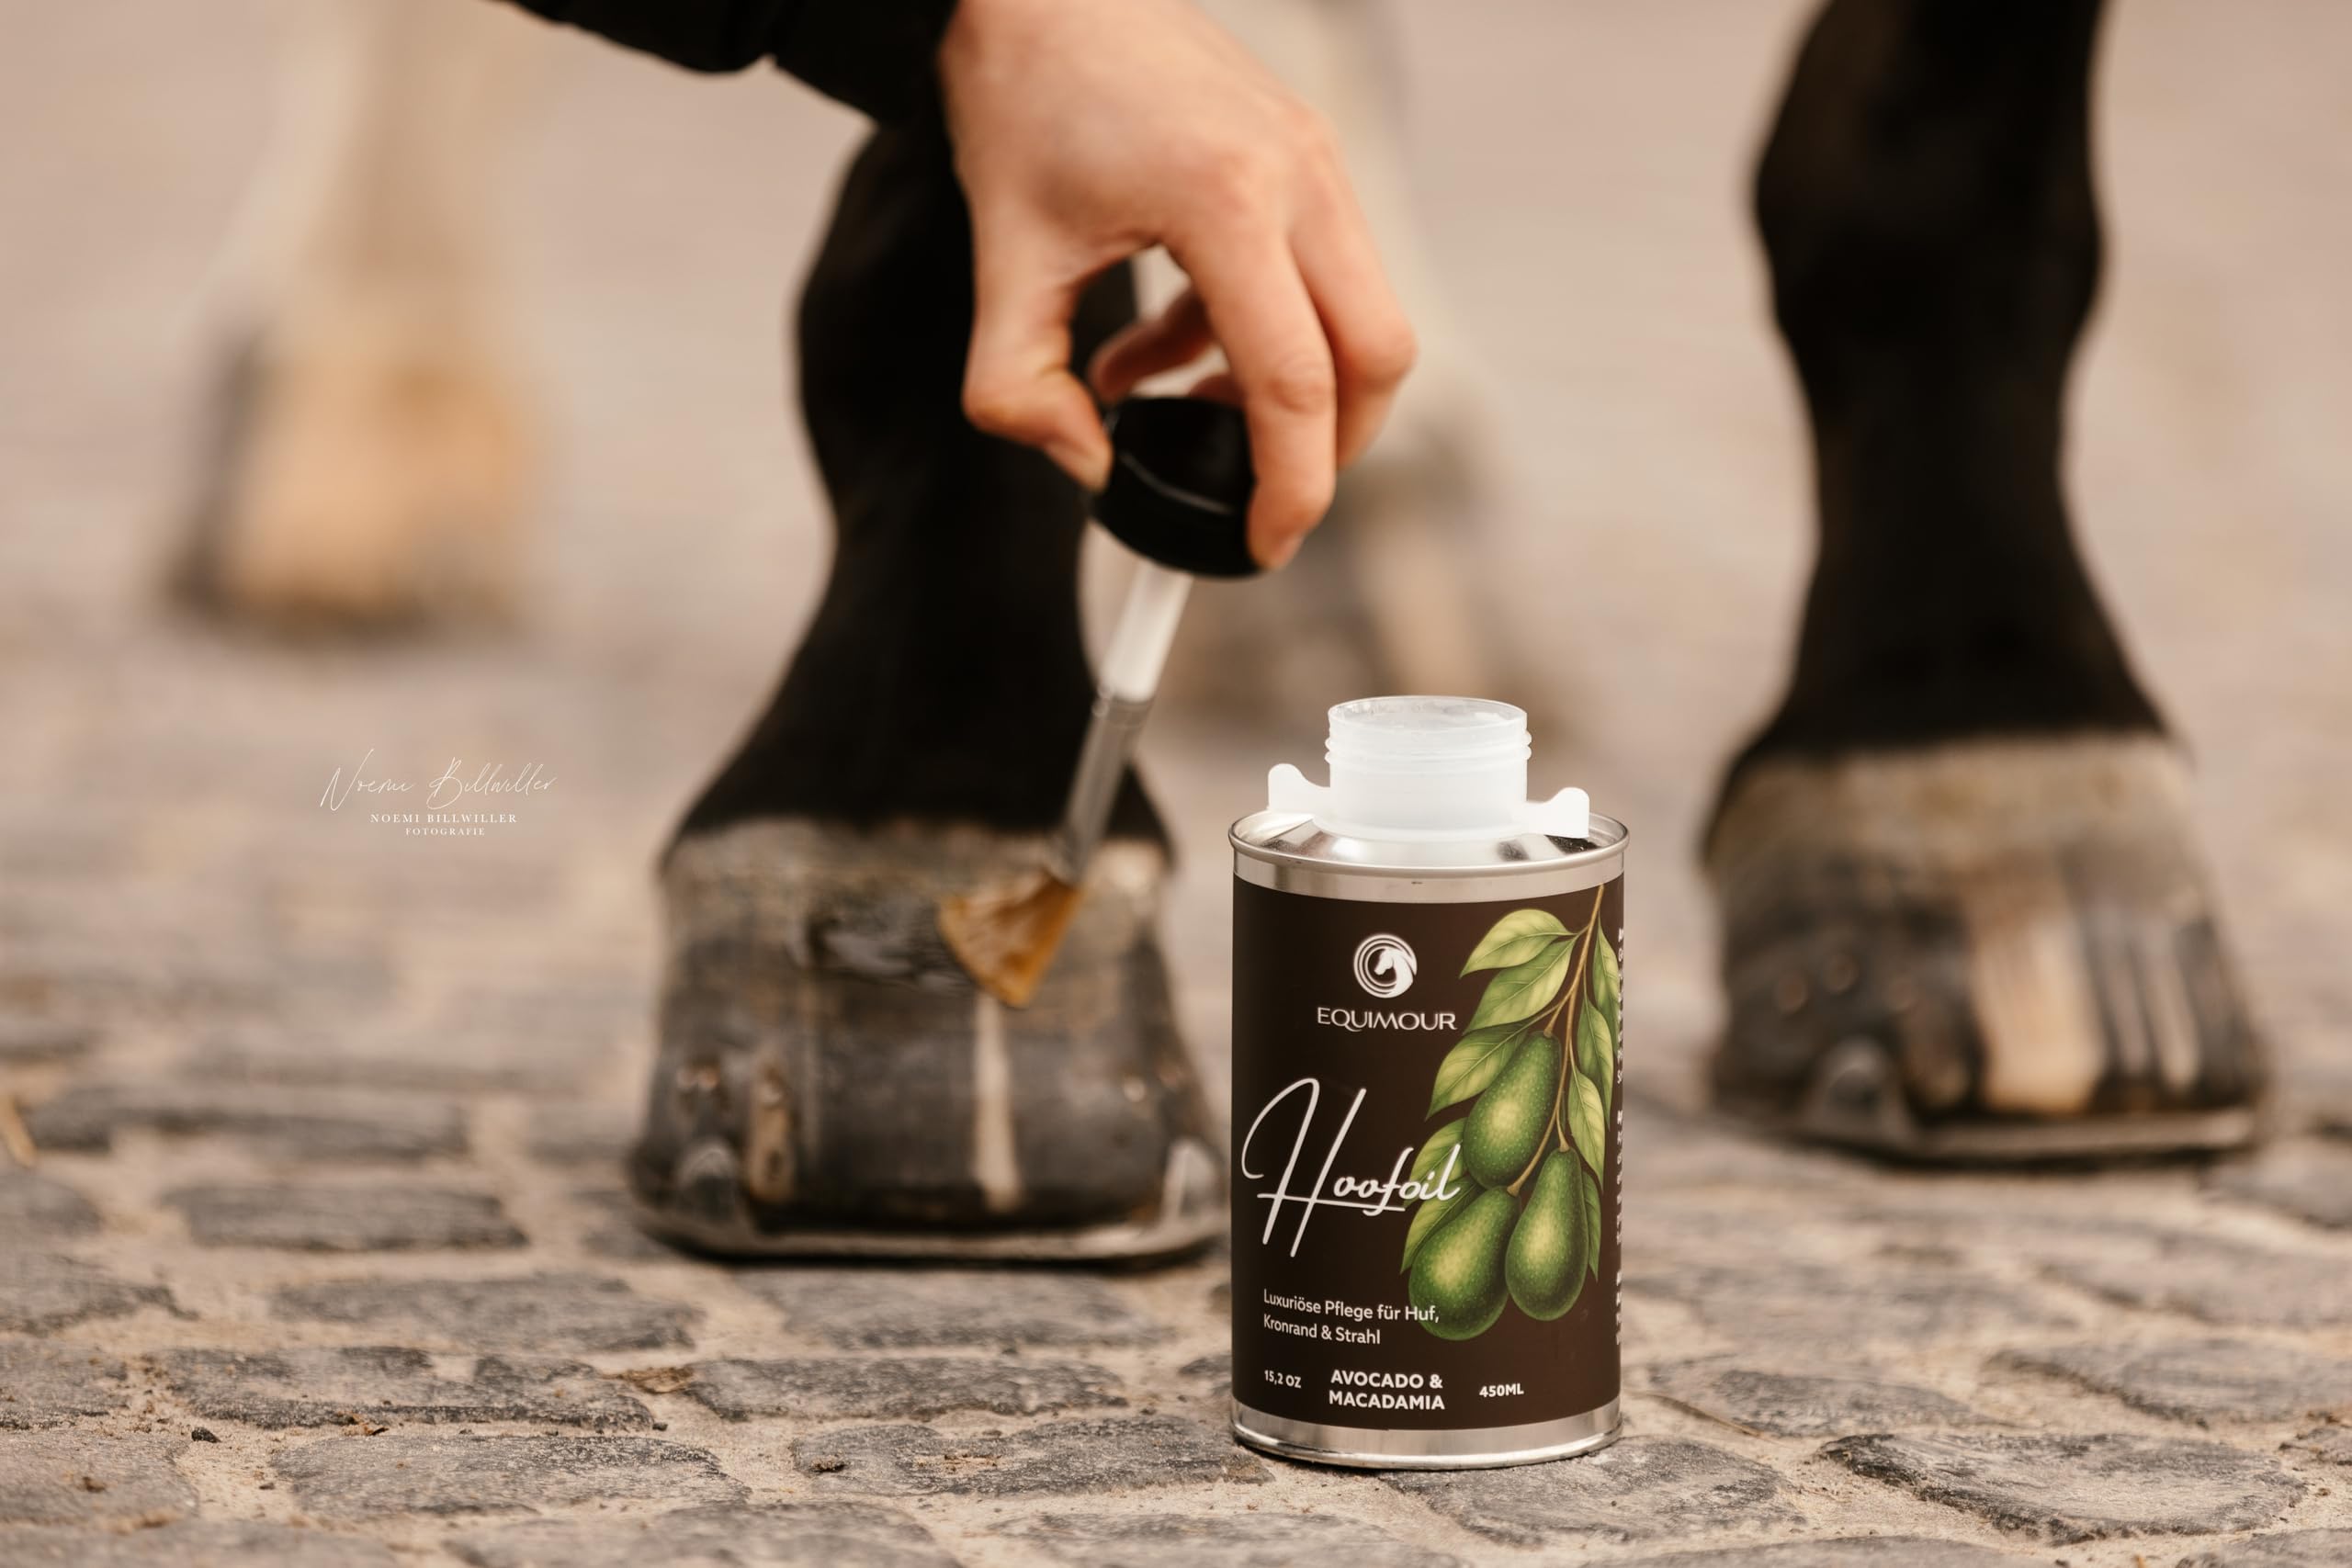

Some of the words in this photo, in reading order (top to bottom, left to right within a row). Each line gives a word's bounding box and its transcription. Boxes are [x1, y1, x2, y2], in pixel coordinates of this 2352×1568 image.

[1317, 1007, 1458, 1032] EQUIMOUR
[1241, 1077, 1461, 1258] Hoofoil
[1263, 1288, 1321, 1314] Luxuriöse
[1325, 1300, 1374, 1322] Pflege
[1377, 1303, 1401, 1320] für
[1404, 1304, 1440, 1324] Huf,
[1263, 1314, 1317, 1338] Kronrand
[1320, 1325, 1333, 1340] &
[1336, 1325, 1381, 1345] Strahl
[1264, 1370, 1283, 1386] 15,2
[1285, 1374, 1302, 1389] OZ
[1330, 1369, 1425, 1389] AVOCADO
[1429, 1372, 1443, 1389] &
[1479, 1382, 1525, 1398] 450ML
[1329, 1391, 1445, 1410] MACADAMIA
